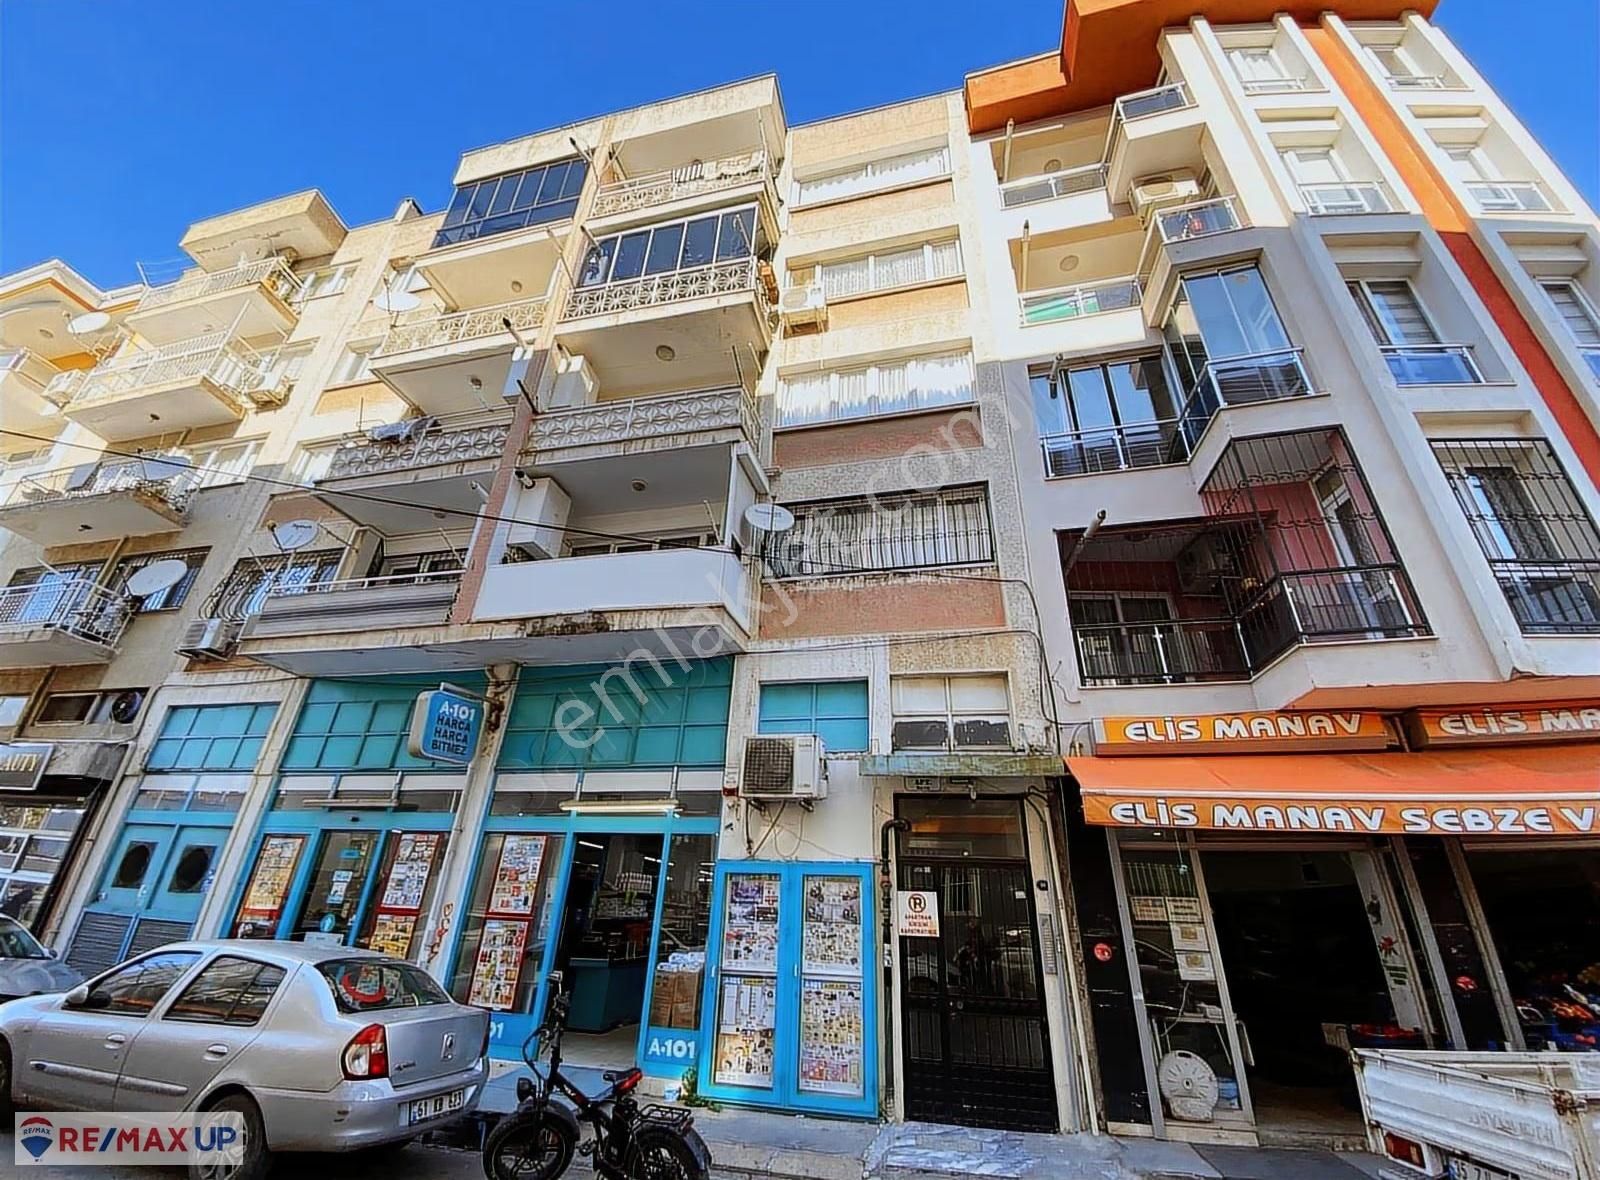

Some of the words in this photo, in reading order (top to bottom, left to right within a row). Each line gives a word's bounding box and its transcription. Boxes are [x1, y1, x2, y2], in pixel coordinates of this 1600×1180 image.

[437, 714, 471, 732] HARCA
[1213, 713, 1361, 740] MANAV
[434, 726, 468, 744] HARCA
[1212, 804, 1384, 831] MANAV
[1400, 808, 1553, 832] SEBZE
